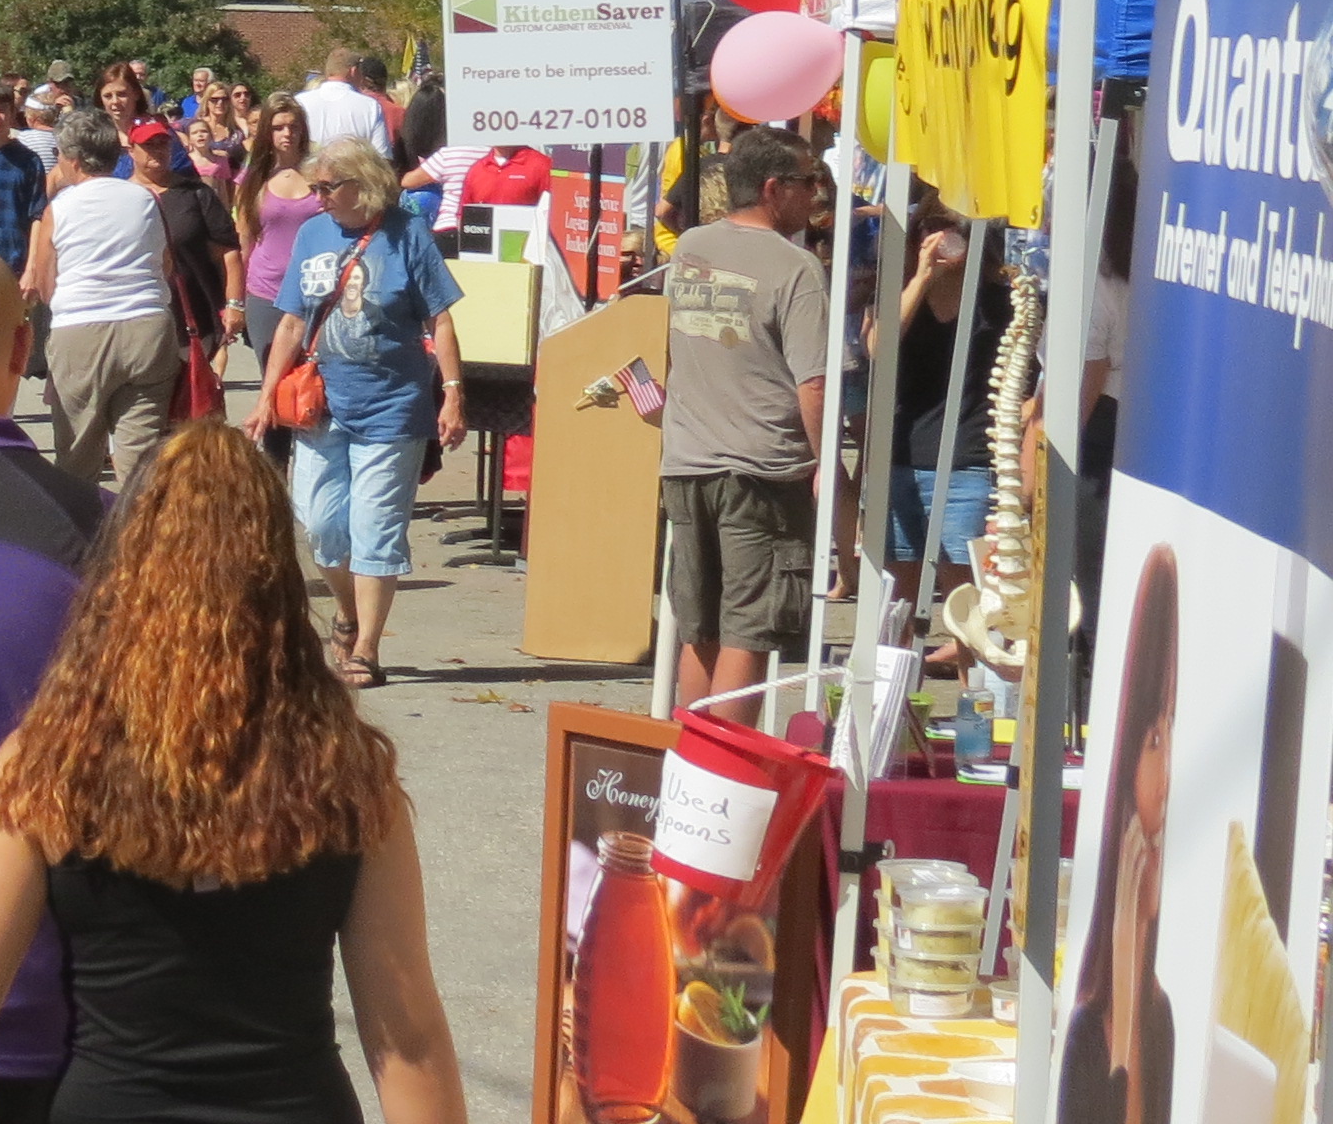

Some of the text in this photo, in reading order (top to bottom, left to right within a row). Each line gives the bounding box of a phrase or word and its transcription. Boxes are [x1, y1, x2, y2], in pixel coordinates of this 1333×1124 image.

[502, 2, 665, 24] KitchenSaver
[503, 21, 634, 33] CUSTOM CABINET RENEWAL
[462, 65, 521, 83] Prepare
[525, 65, 541, 78] to
[545, 64, 565, 78] be
[472, 106, 647, 132] 800-427-0108
[463, 224, 491, 235] SONY
[1153, 190, 1227, 294] Internet
[1227, 200, 1266, 305] and
[585, 768, 661, 824] Honey
[666, 772, 732, 821] Used
